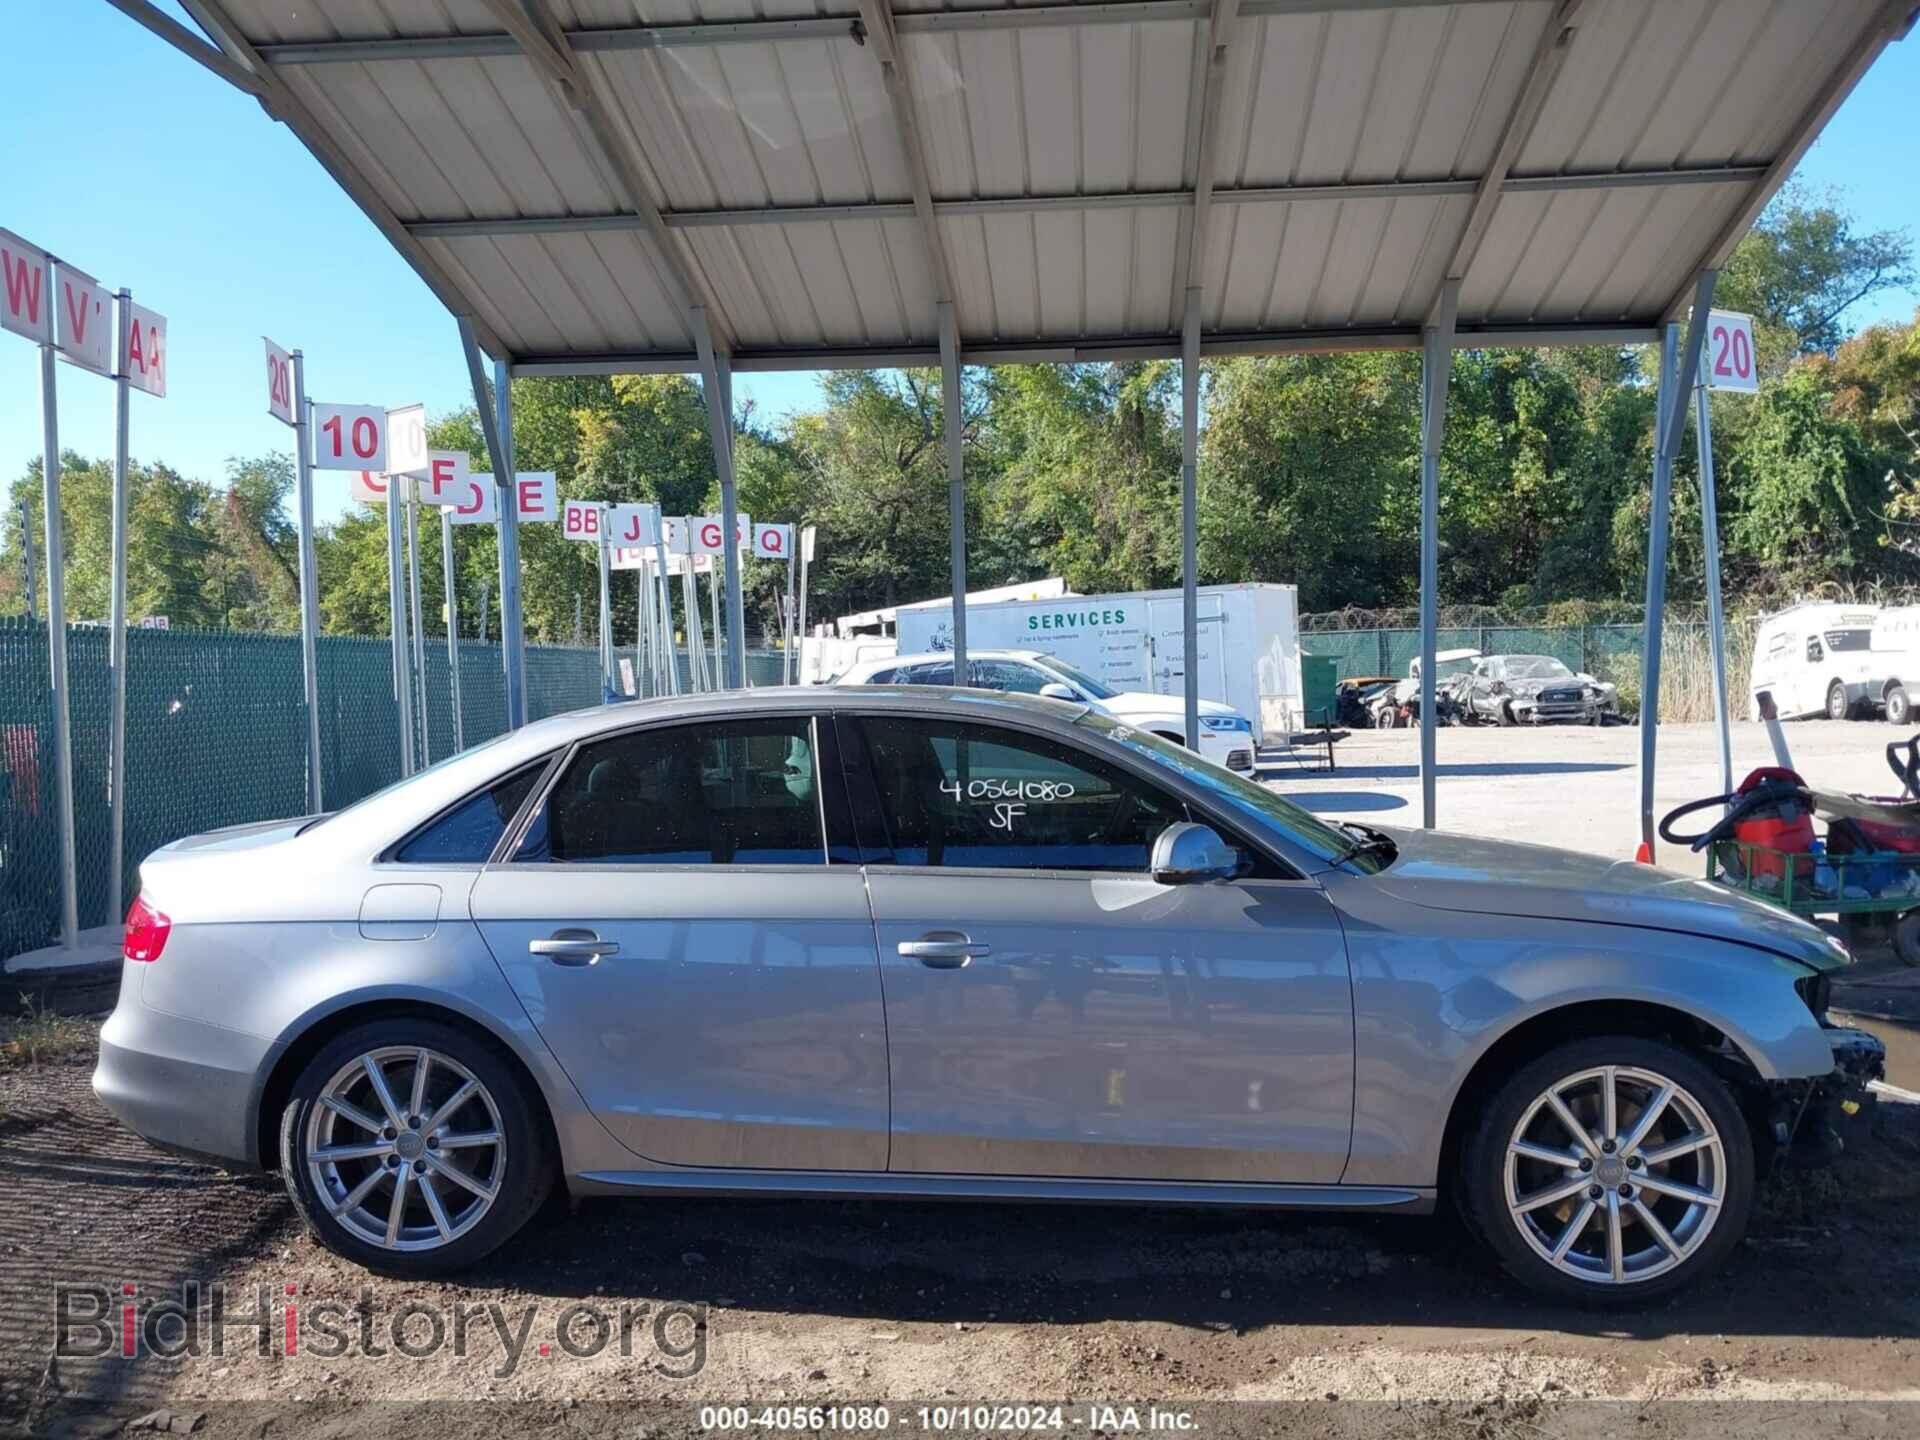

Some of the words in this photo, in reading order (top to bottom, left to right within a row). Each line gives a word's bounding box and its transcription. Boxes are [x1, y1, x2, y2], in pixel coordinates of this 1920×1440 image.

[1, 248, 42, 325] W
[64, 281, 89, 346] V
[128, 317, 162, 381] AA
[1713, 325, 1752, 379] 20
[268, 353, 290, 410] 20
[322, 414, 379, 460] 10
[431, 460, 456, 496] F
[518, 480, 545, 514] E
[567, 507, 598, 534] BB
[623, 515, 641, 542] J
[701, 523, 722, 549] G
[761, 529, 782, 553] Q
[1028, 610, 1126, 631] SERVICES
[939, 778, 1076, 803] 40561080
[988, 803, 1028, 831] SF
